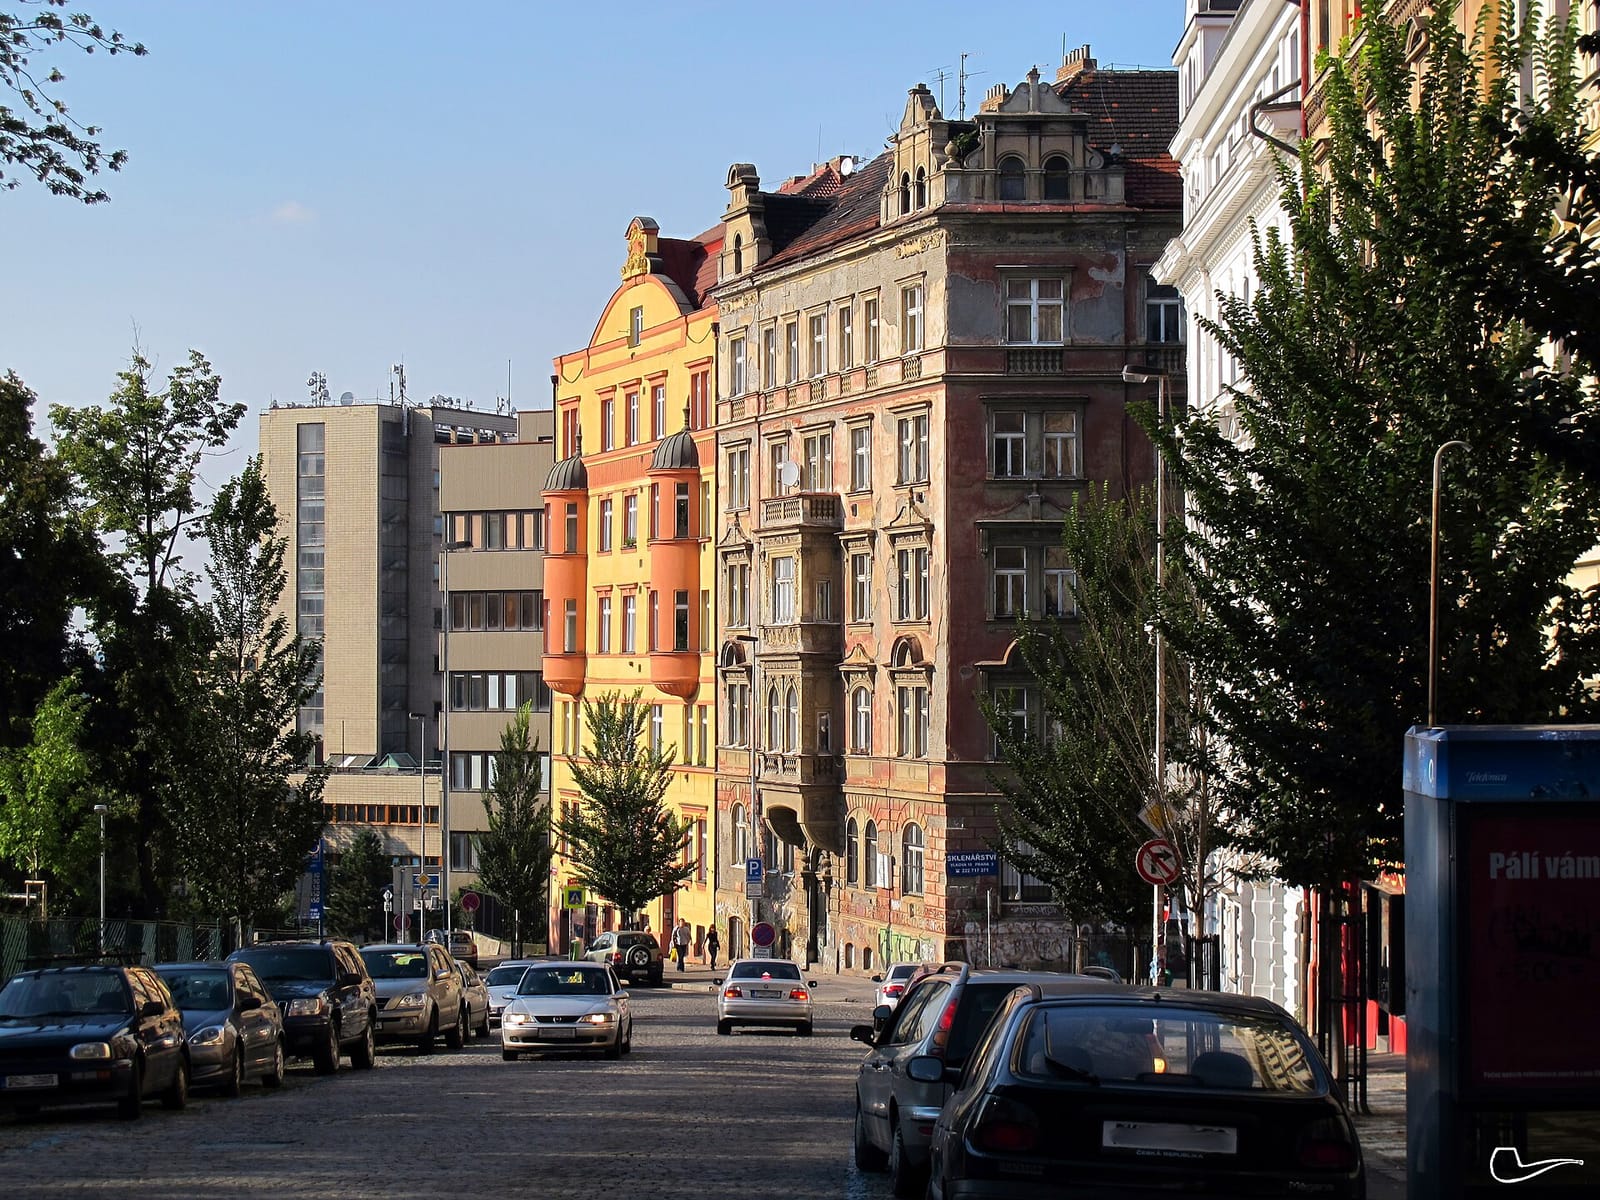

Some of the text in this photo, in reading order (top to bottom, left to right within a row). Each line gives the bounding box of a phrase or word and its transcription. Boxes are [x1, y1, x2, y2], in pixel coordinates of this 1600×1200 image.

[947, 853, 997, 862] SKLENÁŘSTVÍ
[749, 861, 759, 875] P
[1488, 850, 1600, 880] Pálí vám
